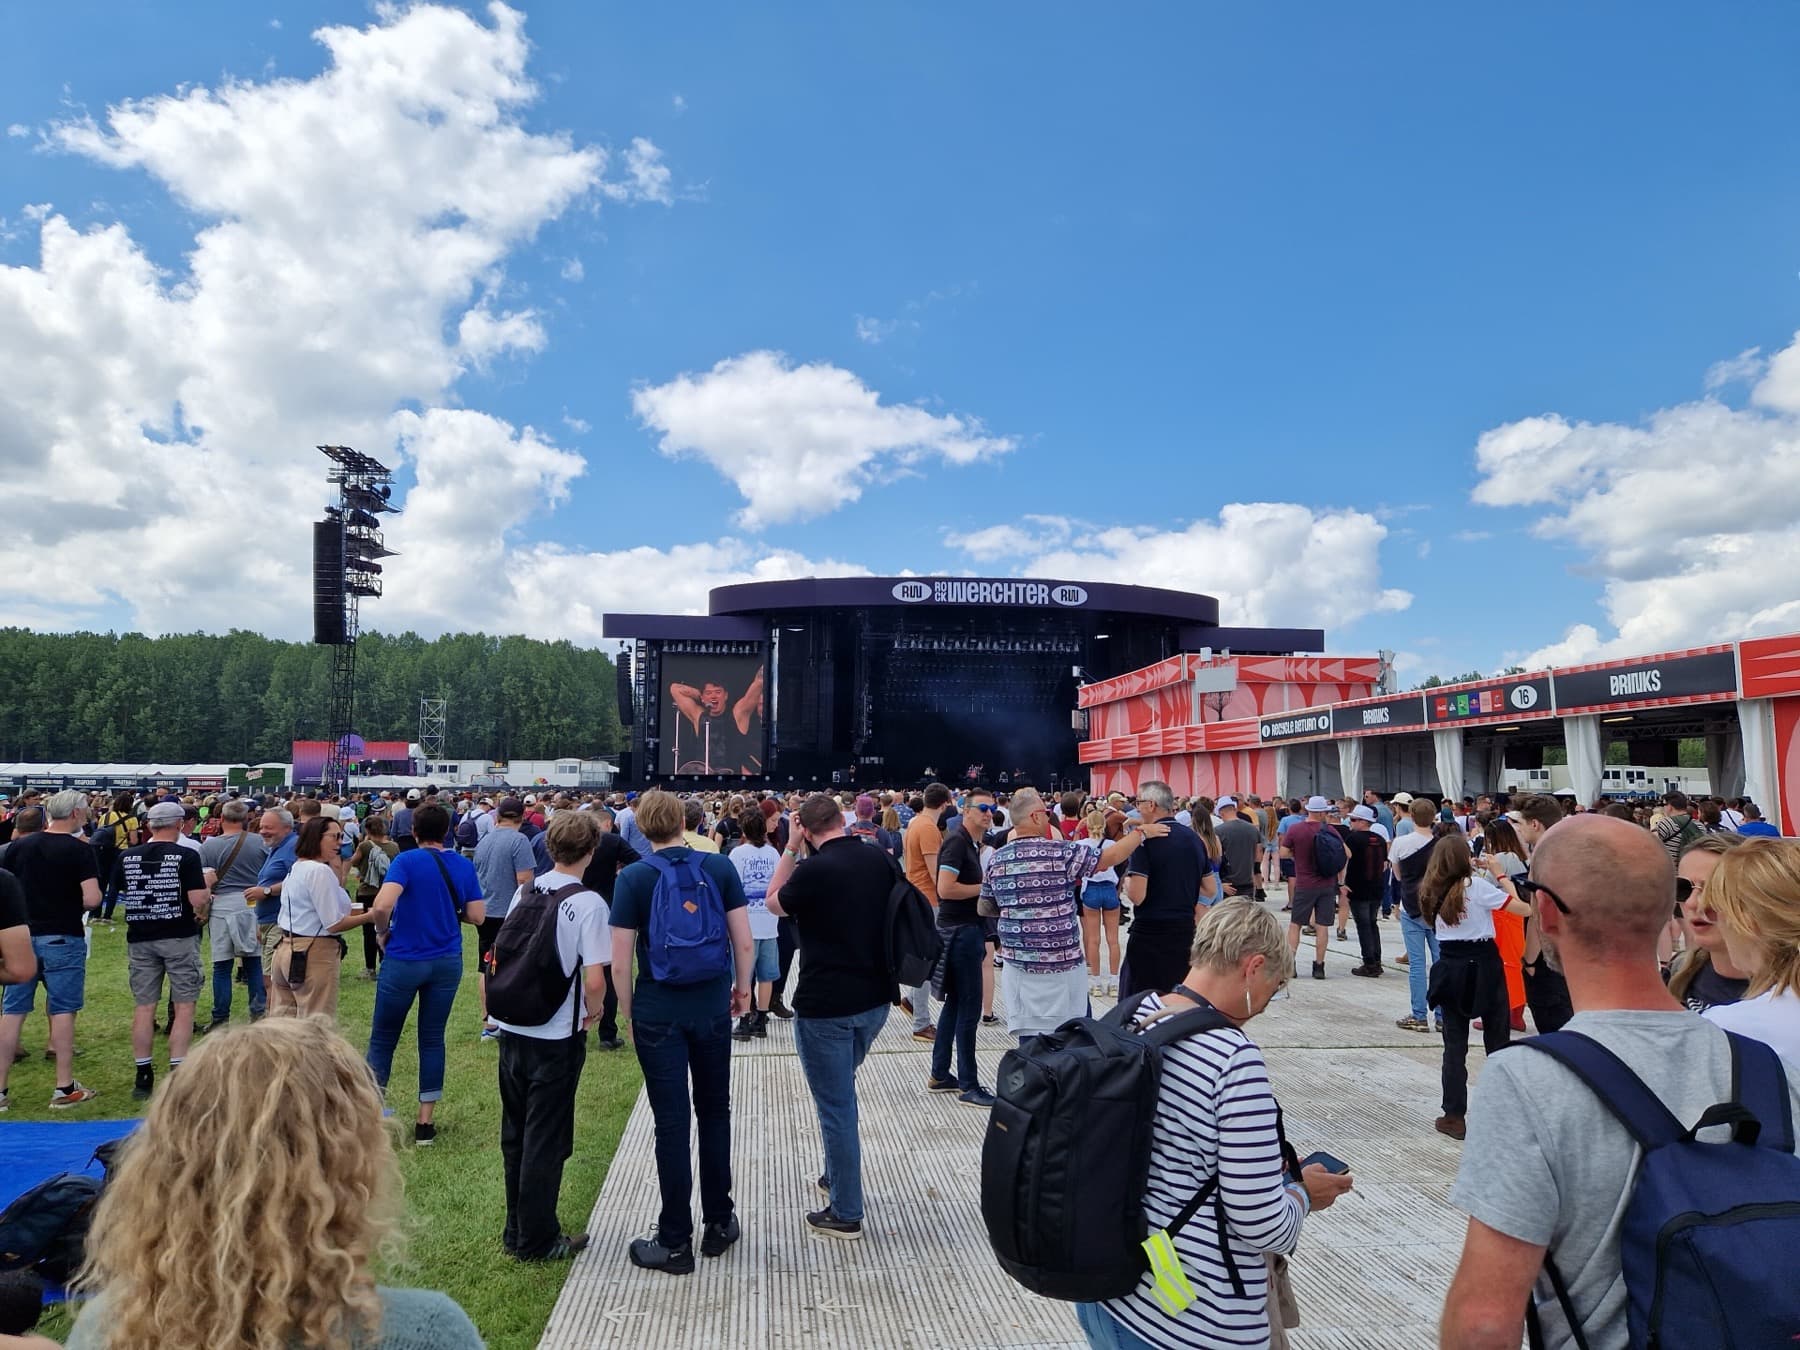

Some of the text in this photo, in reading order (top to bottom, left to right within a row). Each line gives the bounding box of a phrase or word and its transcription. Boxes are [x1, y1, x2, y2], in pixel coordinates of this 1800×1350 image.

[1609, 669, 1662, 697] DRINKS
[1518, 688, 1530, 705] 16
[1363, 706, 1390, 725] DRINKS
